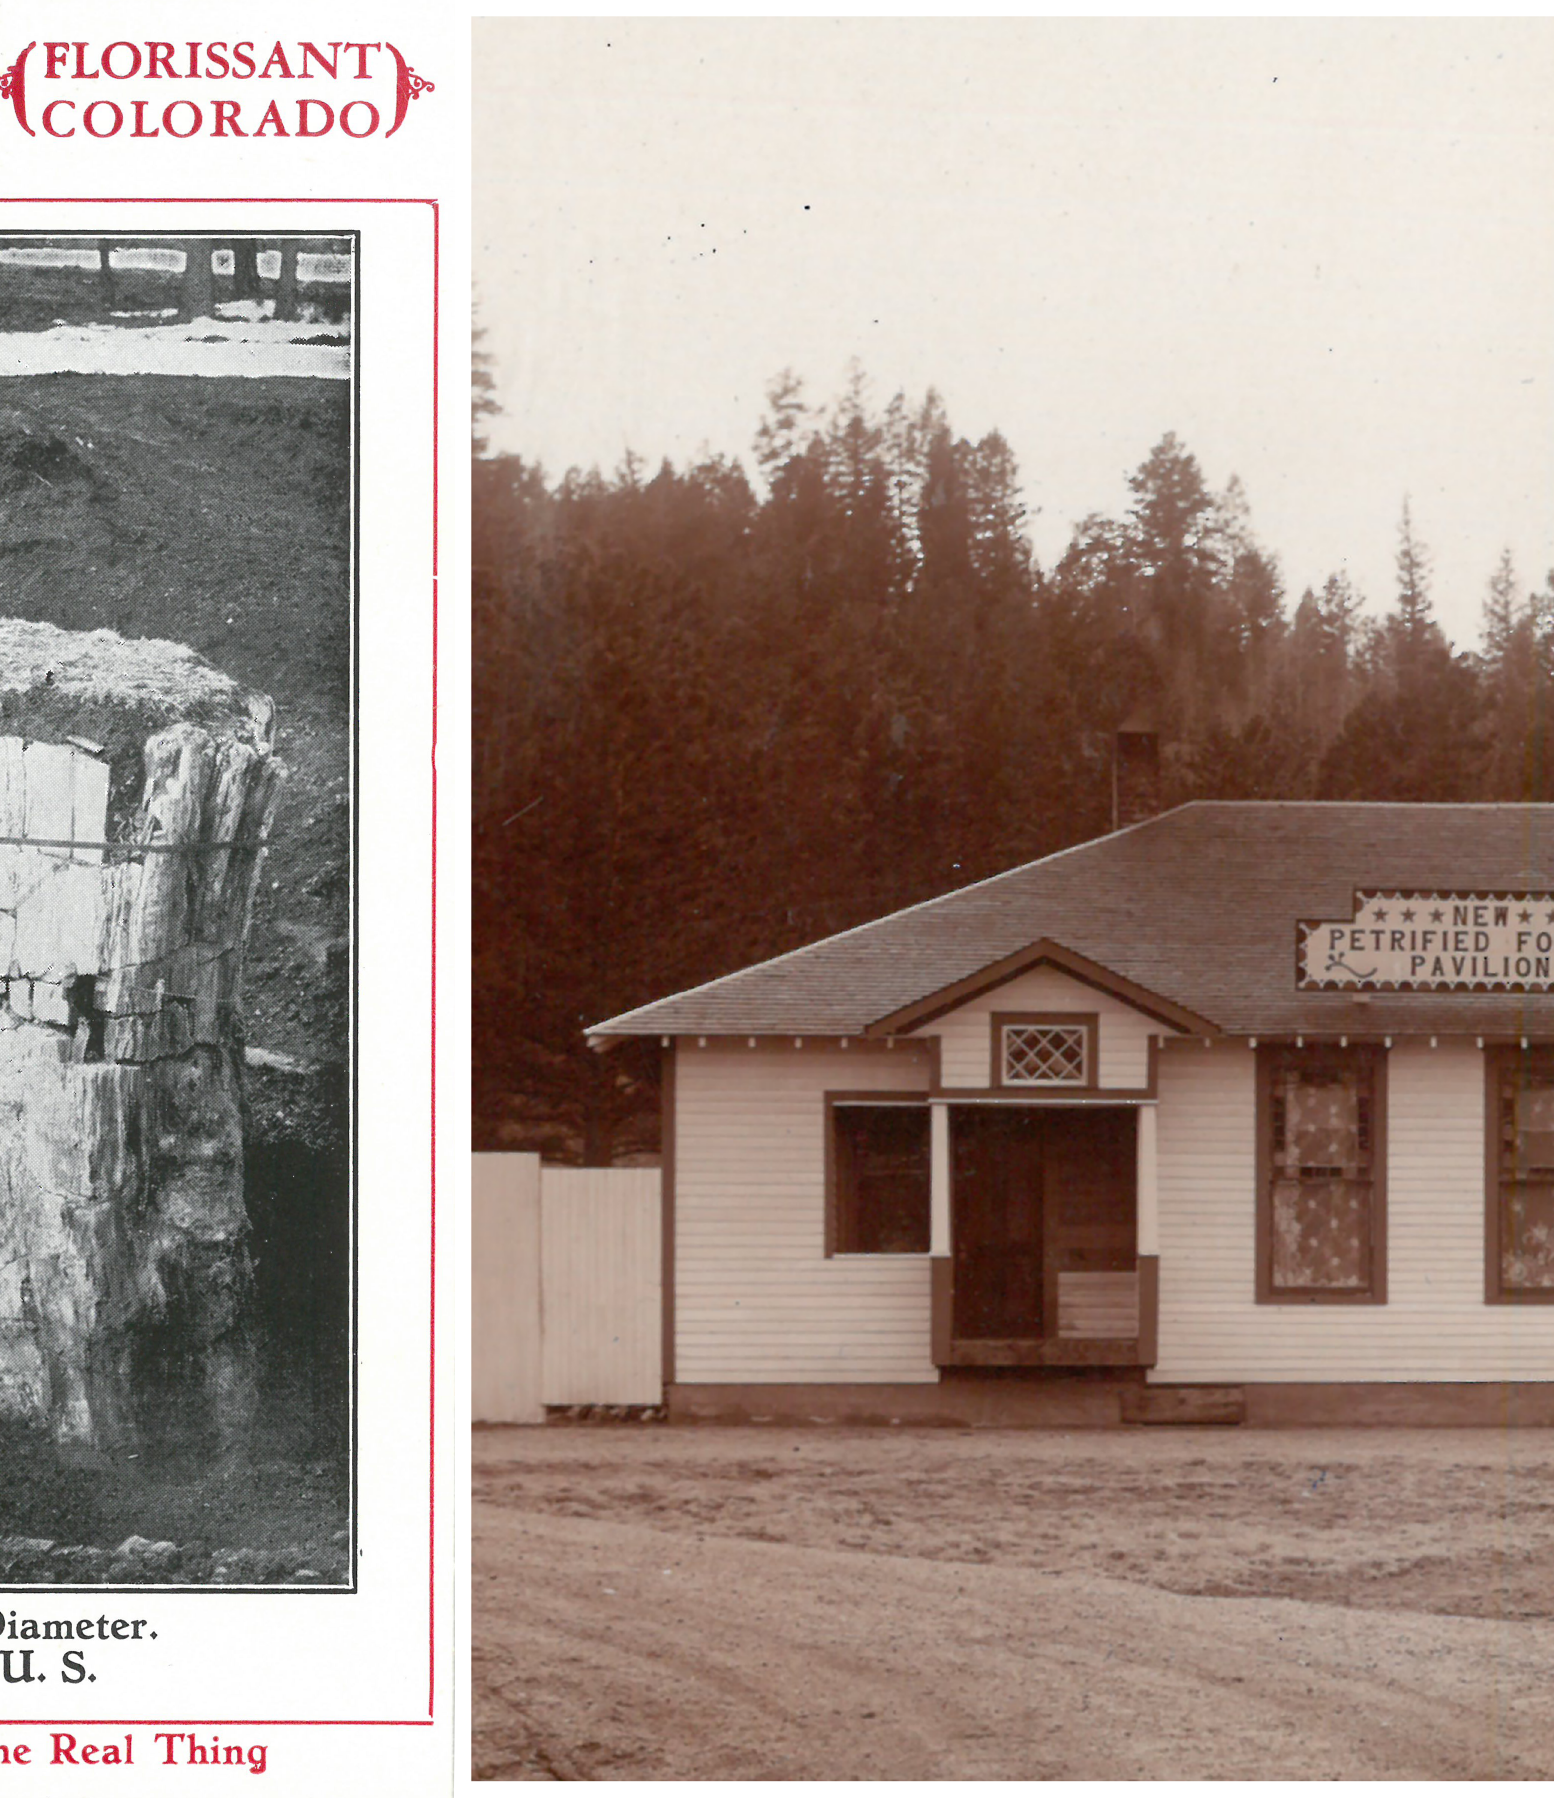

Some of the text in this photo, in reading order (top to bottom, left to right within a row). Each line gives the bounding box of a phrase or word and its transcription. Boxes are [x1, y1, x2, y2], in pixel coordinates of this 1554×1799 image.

[43, 40, 382, 80] FLORISSANT
[42, 99, 380, 139] COLORADO
[1452, 905, 1510, 928] NEW
[1329, 929, 1491, 953] PETRIFIED
[1410, 955, 1551, 978] PAVILION
[0, 1649, 47, 1684] U.
[62, 1650, 97, 1684] S.
[50, 1732, 135, 1765] Real
[154, 1732, 268, 1774] Thing
